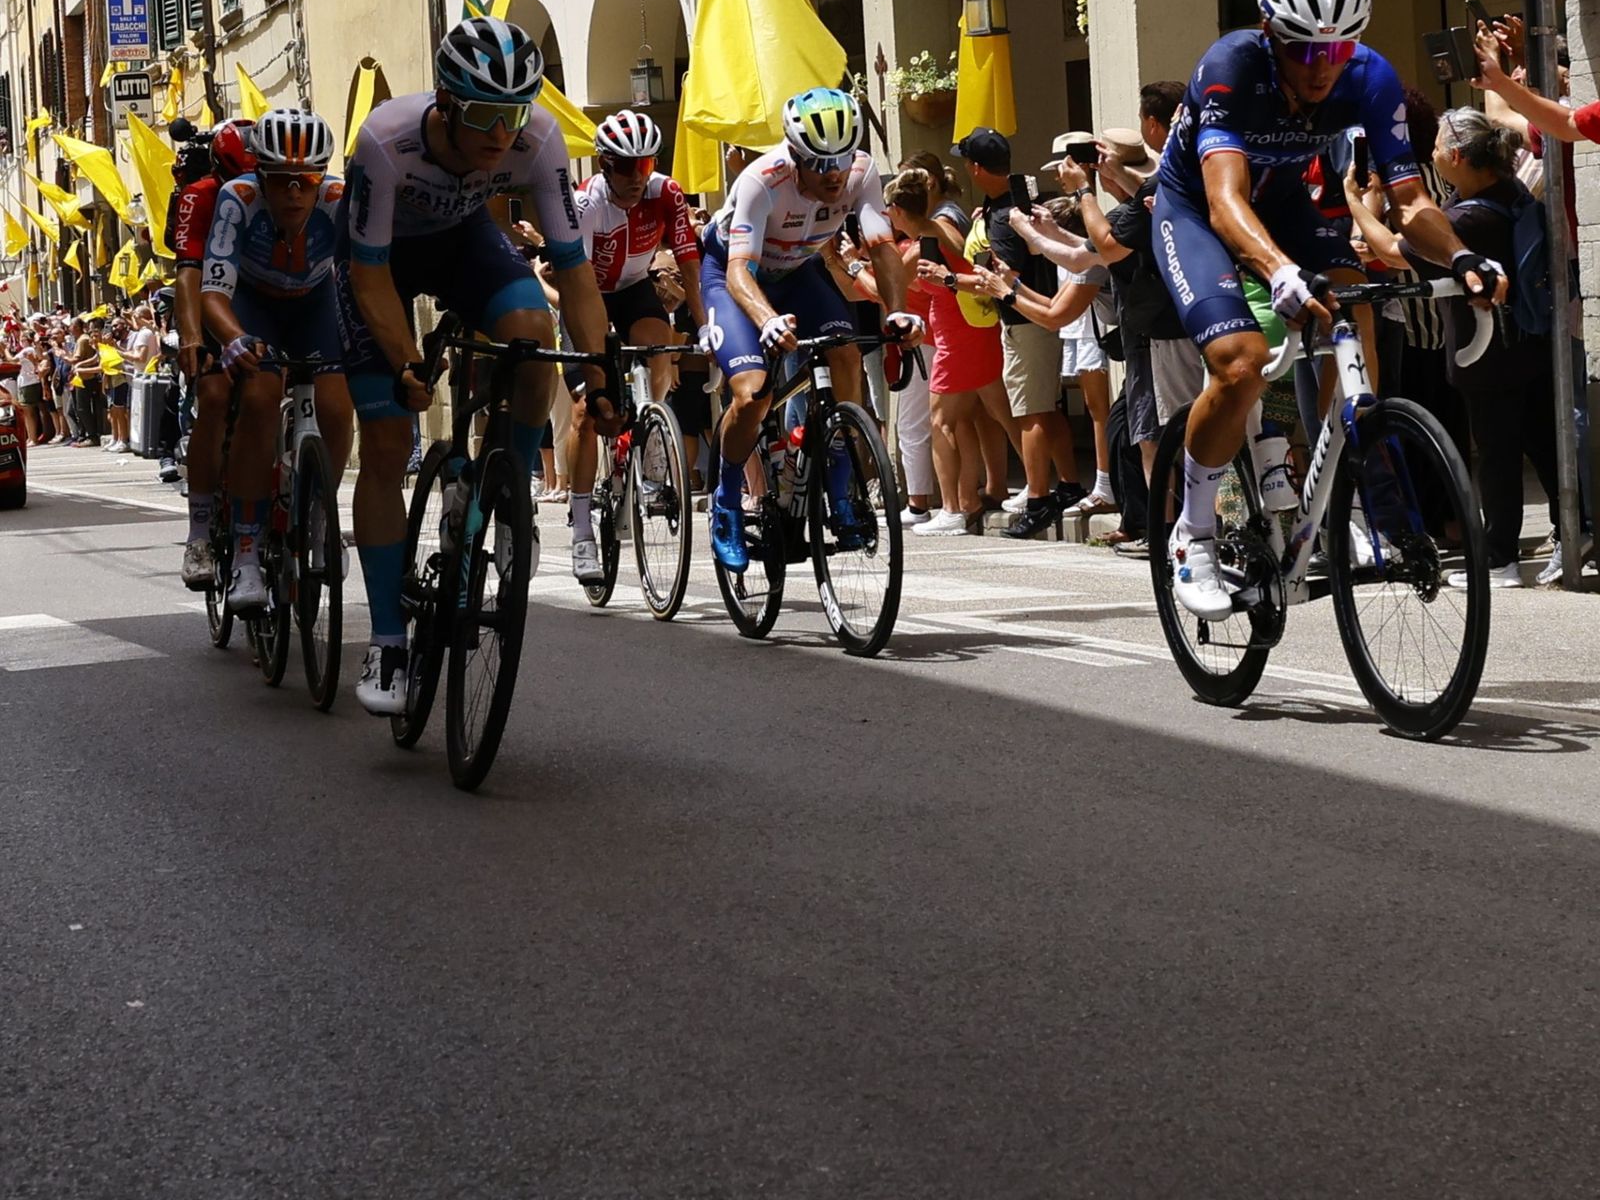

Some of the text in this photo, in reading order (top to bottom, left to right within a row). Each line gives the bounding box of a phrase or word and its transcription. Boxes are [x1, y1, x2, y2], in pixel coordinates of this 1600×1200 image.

[111, 22, 146, 31] TABACCHI
[115, 78, 149, 96] LOTTO
[666, 179, 689, 244] Cofidis
[1160, 219, 1196, 306] Groupama
